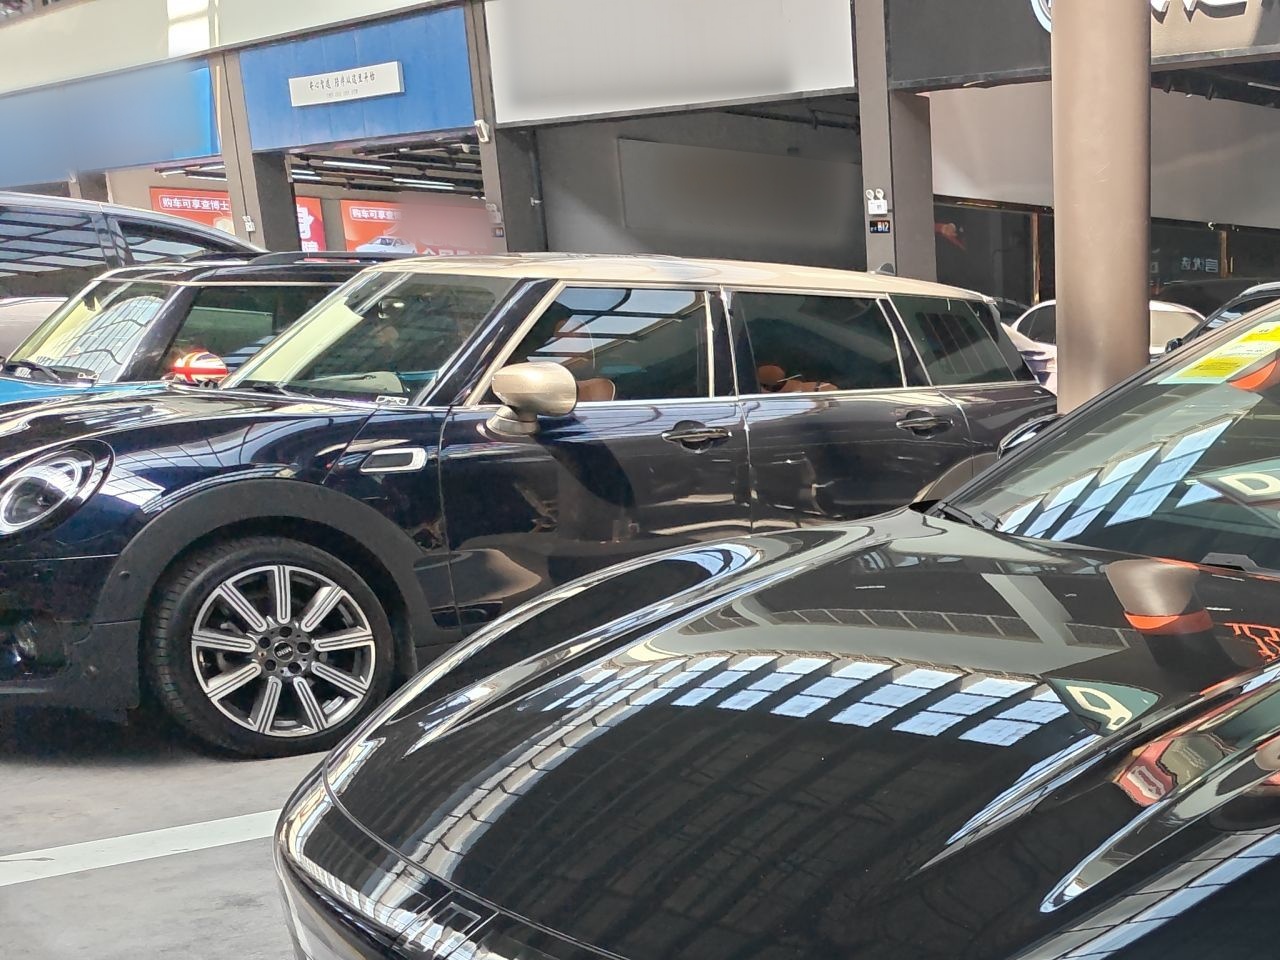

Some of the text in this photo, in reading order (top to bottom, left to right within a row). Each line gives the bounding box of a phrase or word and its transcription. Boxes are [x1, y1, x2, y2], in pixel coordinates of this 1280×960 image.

[162, 197, 230, 211] 购车可享查博士
